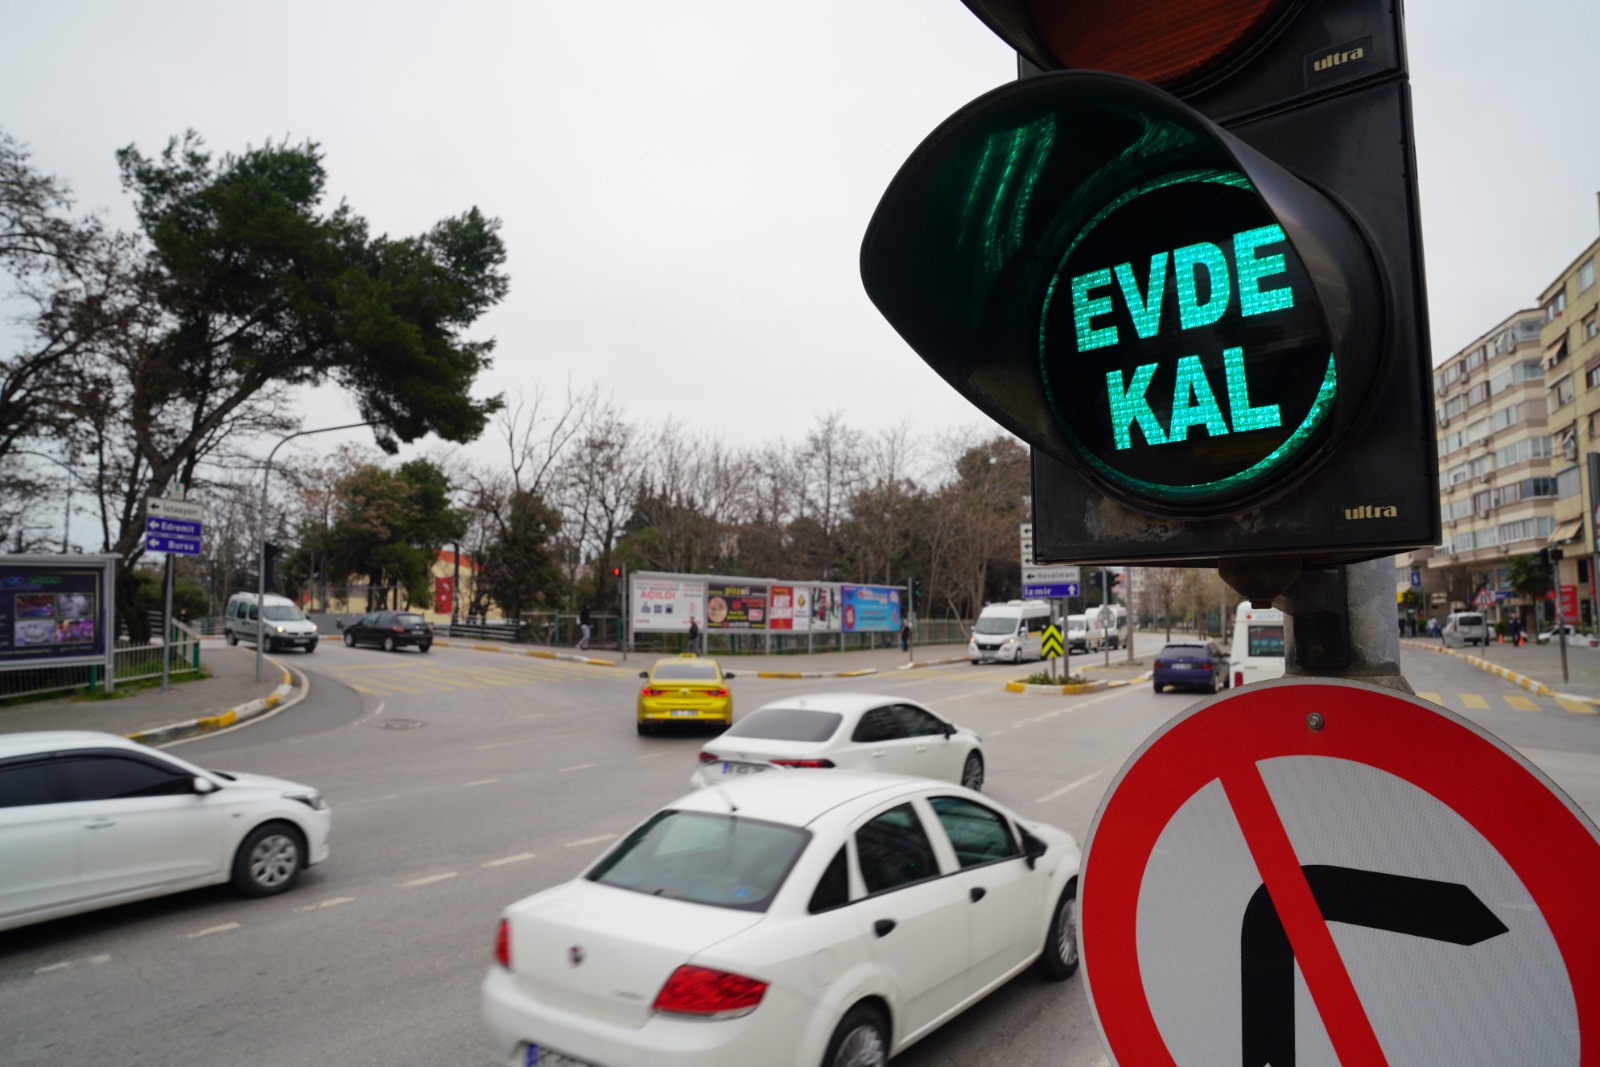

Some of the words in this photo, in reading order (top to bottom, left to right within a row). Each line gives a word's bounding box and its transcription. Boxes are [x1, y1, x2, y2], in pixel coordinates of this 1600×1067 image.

[1313, 47, 1364, 72] ultra
[1071, 223, 1294, 352] EVDE
[1106, 346, 1281, 450] KAL
[1344, 504, 1398, 520] ultra
[161, 521, 195, 534] Edremit
[168, 540, 195, 551] Bursa
[1024, 585, 1052, 597] İzmir
